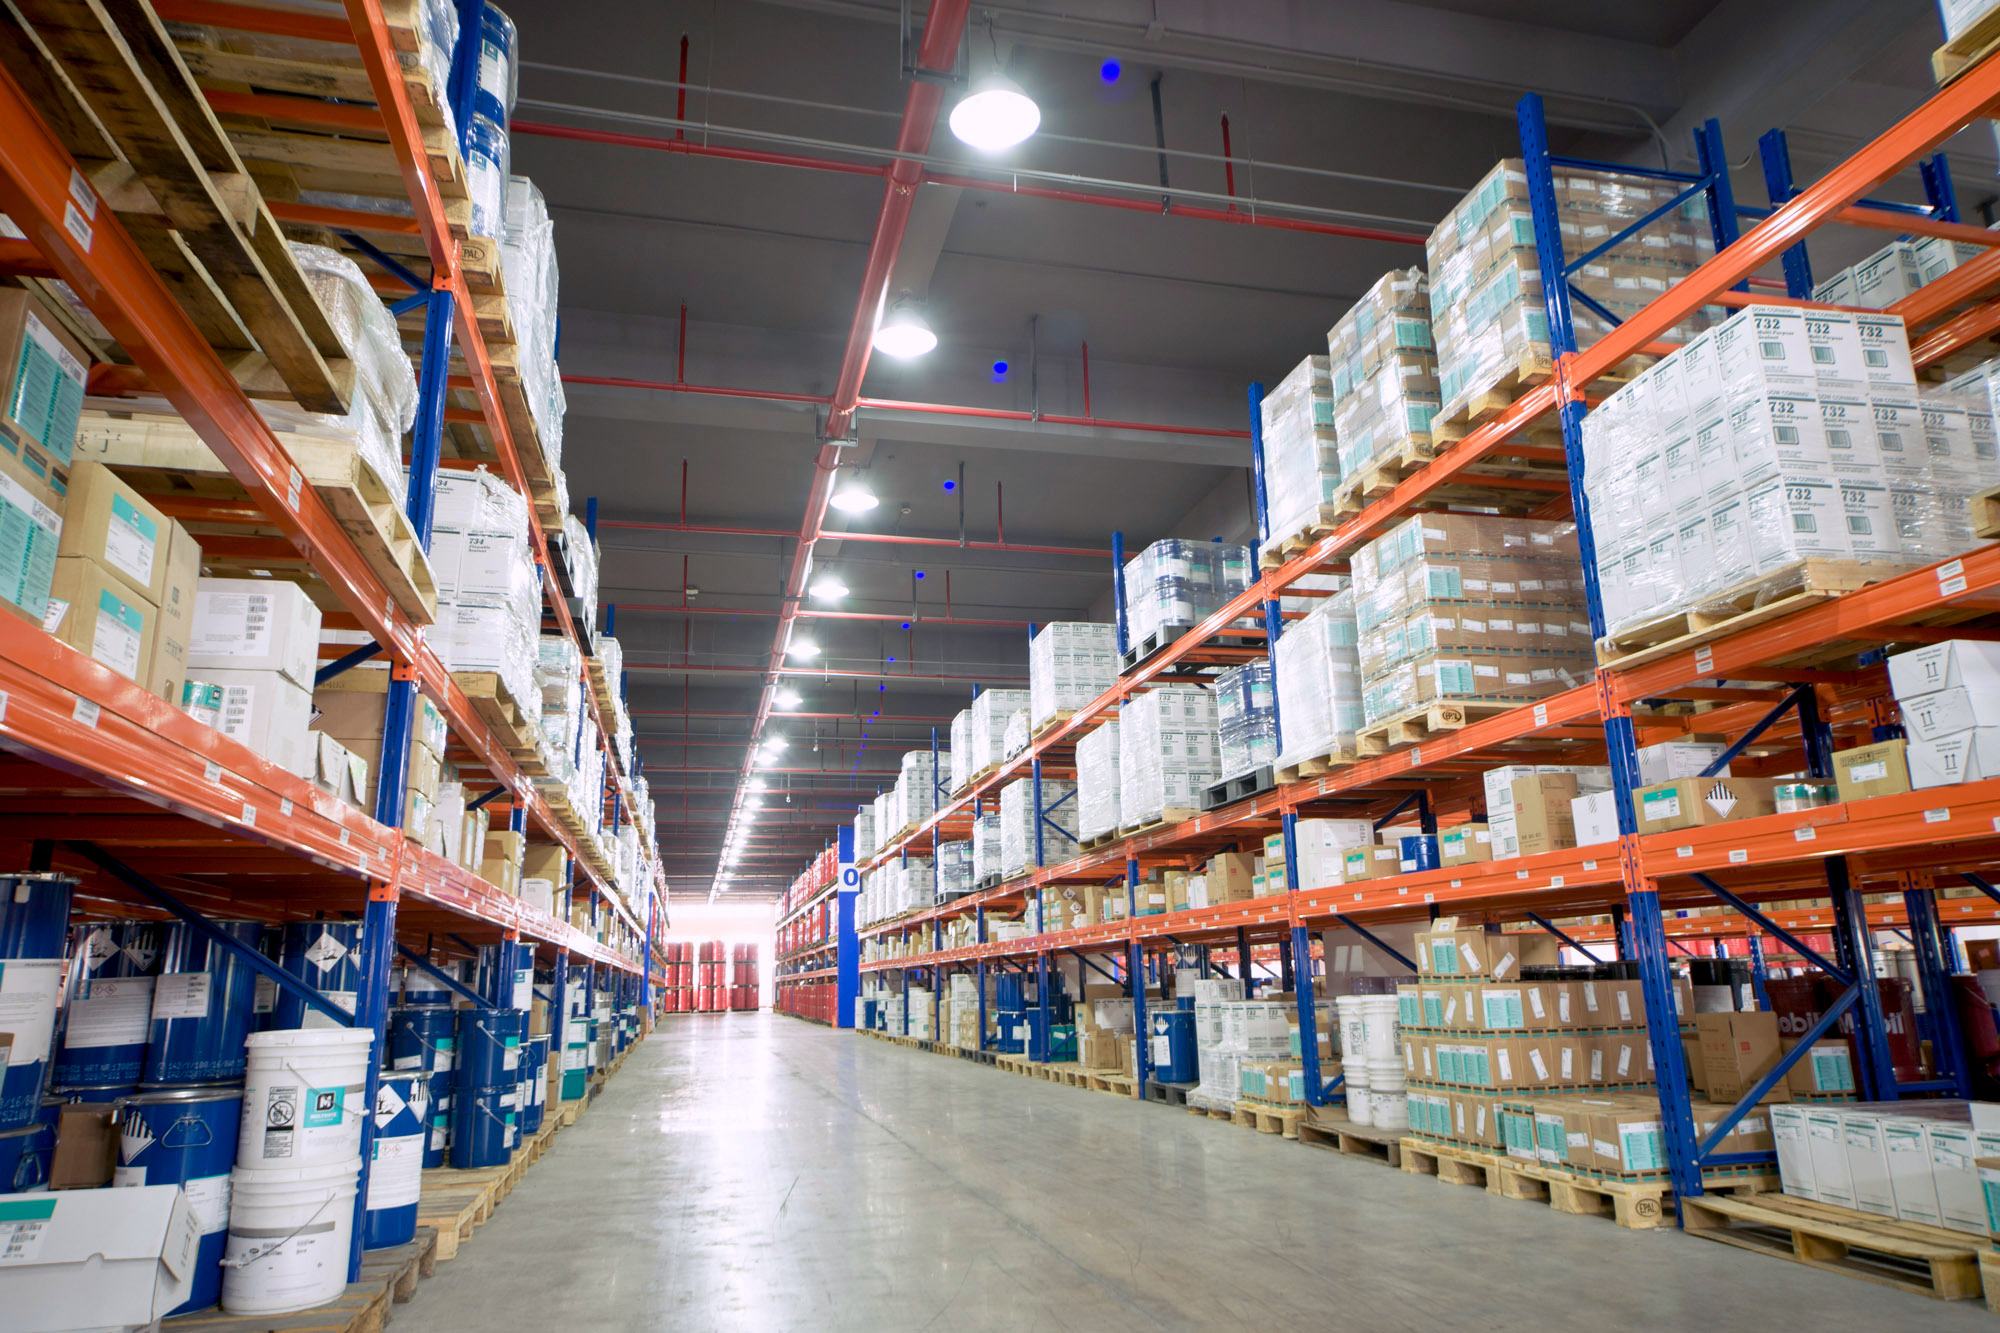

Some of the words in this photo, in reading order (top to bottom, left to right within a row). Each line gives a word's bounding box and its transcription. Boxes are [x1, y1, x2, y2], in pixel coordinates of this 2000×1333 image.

[1754, 318, 1781, 330] 732
[1805, 322, 1830, 334] 732
[1857, 326, 1884, 338] 732
[48, 370, 62, 419] CORNING
[1768, 401, 1794, 414] 732
[1820, 405, 1846, 417] 732
[1873, 408, 1898, 420] 732
[1922, 412, 1946, 425] 732
[1968, 417, 1991, 430] 732
[1786, 488, 1812, 500] 732
[1841, 490, 1866, 503] 732
[22, 525, 35, 576] CORNING
[1640, 1202, 1656, 1214] EPAL
